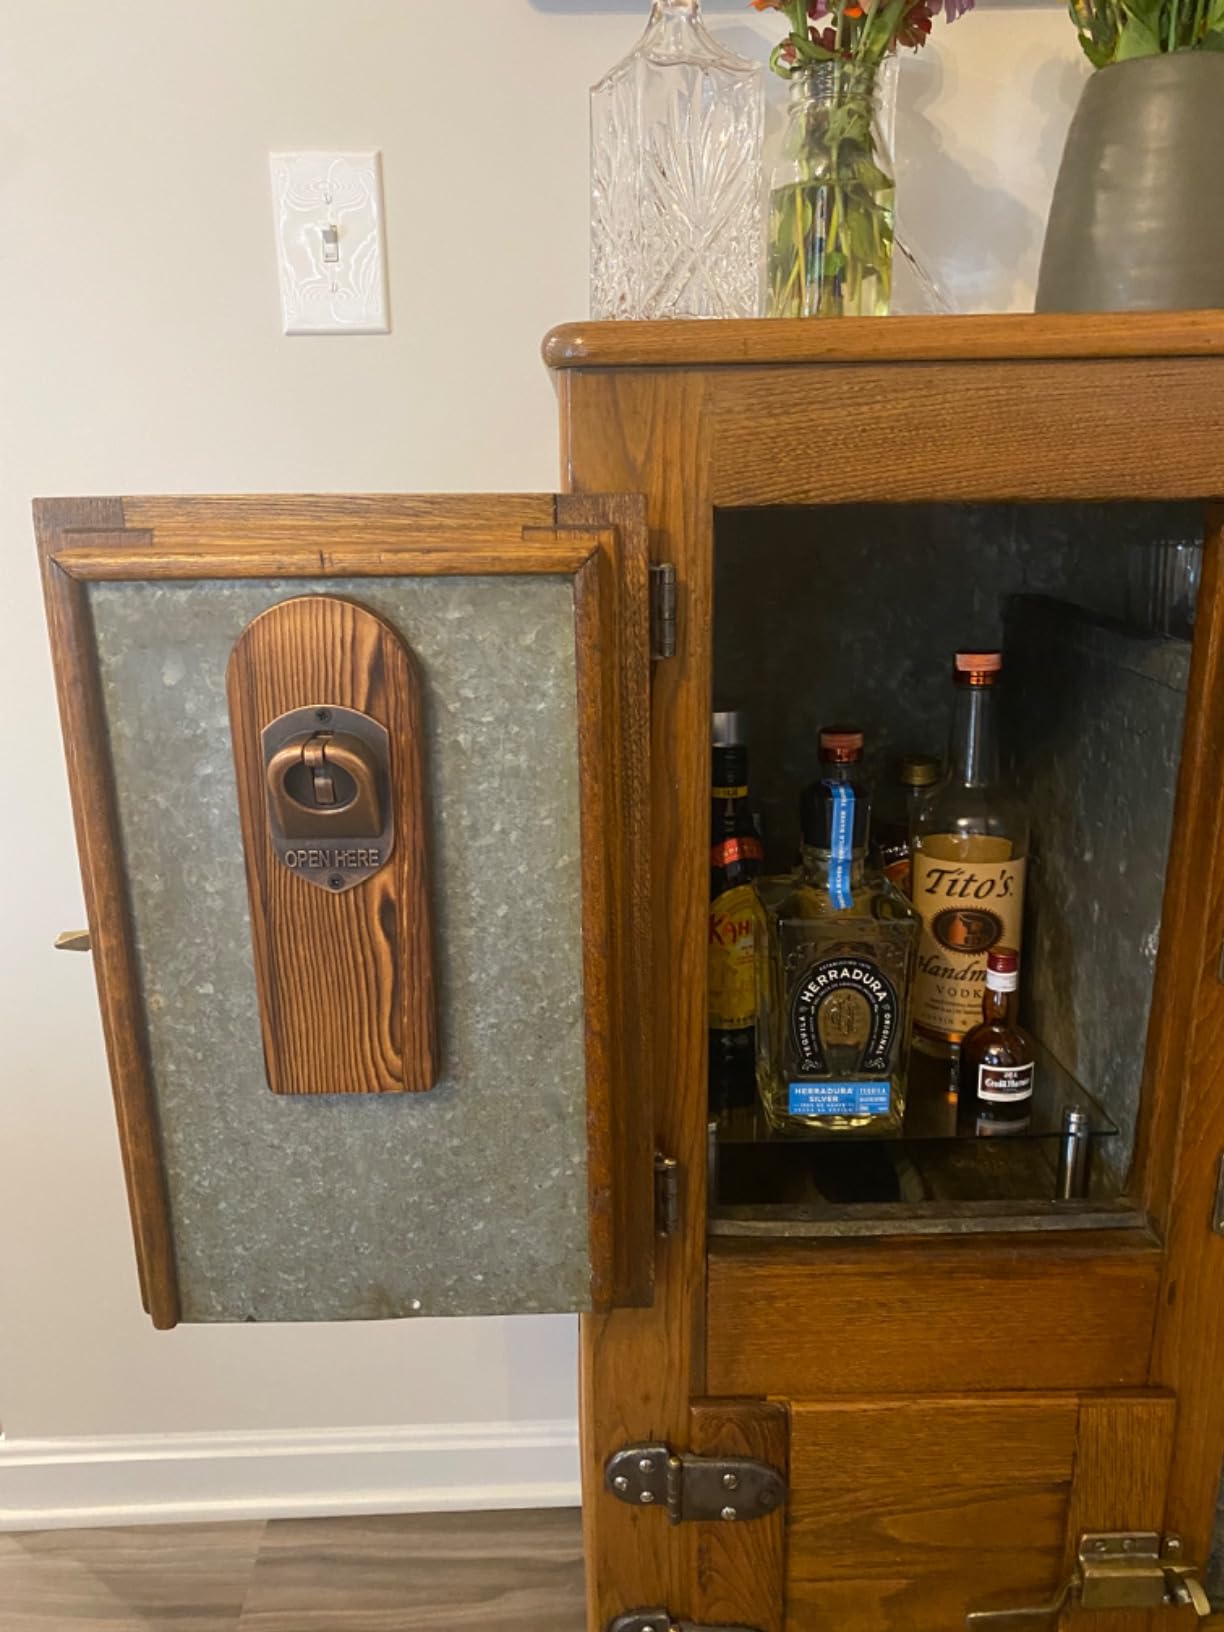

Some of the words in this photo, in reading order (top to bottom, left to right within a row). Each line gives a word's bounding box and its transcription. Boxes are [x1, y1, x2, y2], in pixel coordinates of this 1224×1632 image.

[285, 850, 329, 868] OPEN
[335, 850, 379, 867] HERE
[709, 912, 750, 947] KAH
[918, 955, 987, 982] Handm
[801, 967, 888, 1002] HERRADURA
[936, 984, 983, 999] VODK
[799, 1016, 813, 1057] TEQUILA
[795, 1087, 853, 1095] HERRADURA
